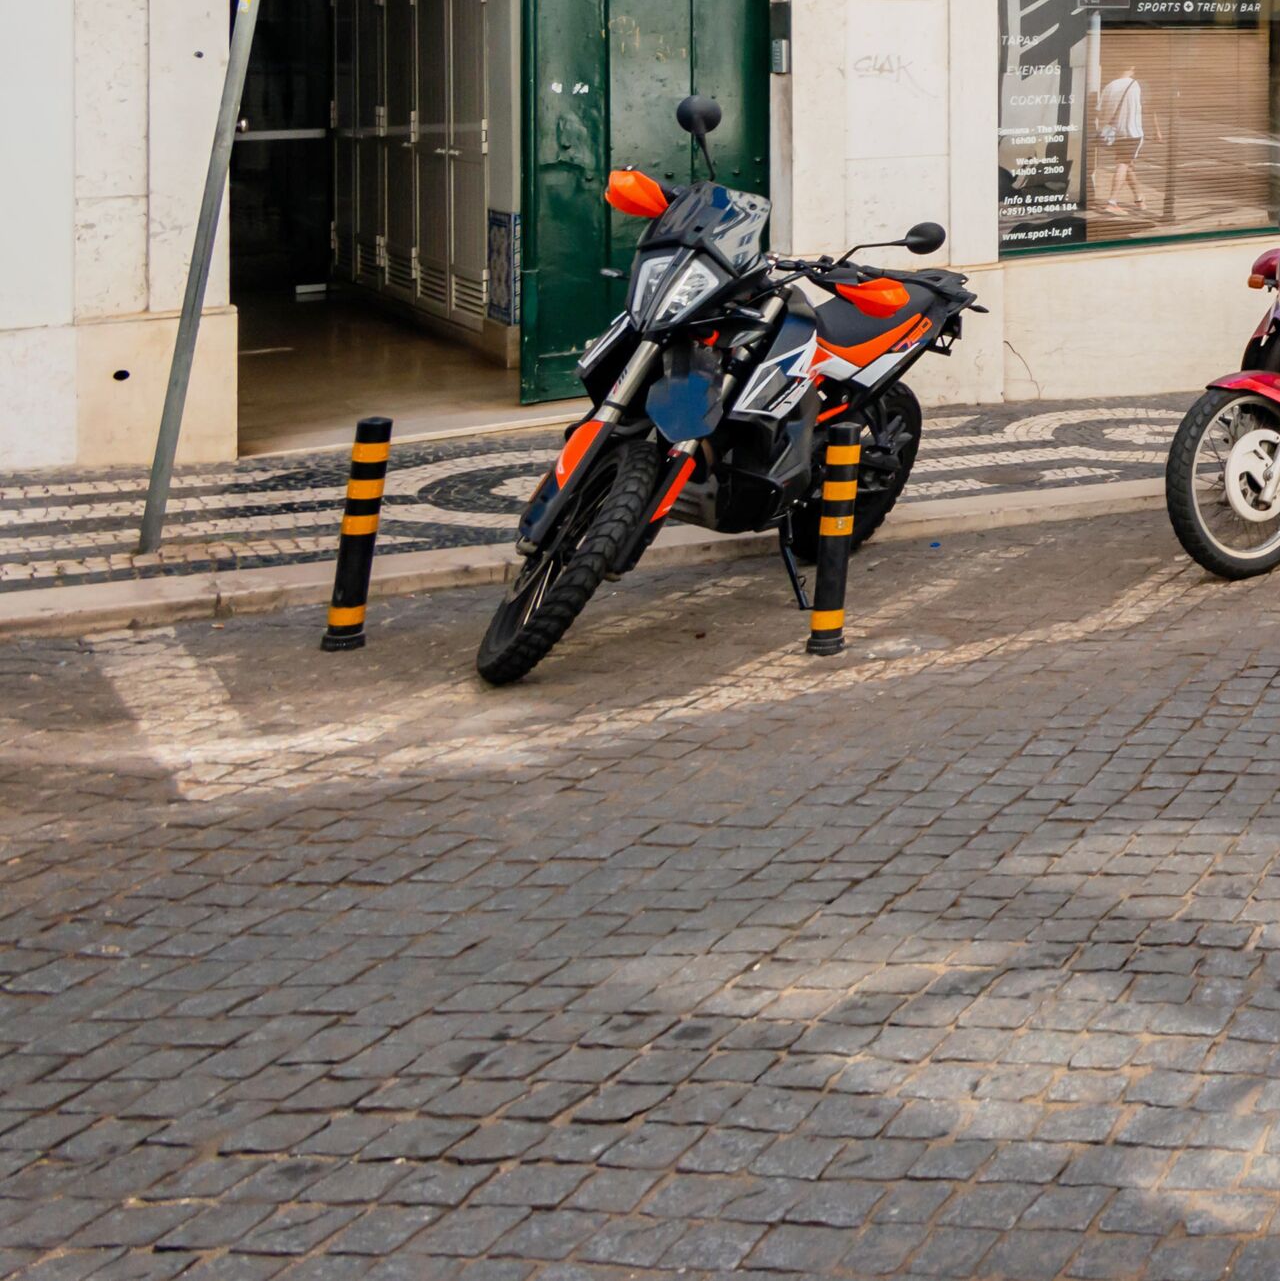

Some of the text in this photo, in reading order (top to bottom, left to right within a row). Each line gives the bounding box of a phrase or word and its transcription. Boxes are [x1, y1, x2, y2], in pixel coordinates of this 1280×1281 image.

[1137, 2, 1262, 12] SPORTS TRENDY BAR
[1001, 35, 1040, 46] TAPAS
[1006, 65, 1061, 76] EVENTOS
[1009, 94, 1075, 106] COCKTAILS
[1037, 125, 1053, 133] The
[1011, 168, 1036, 177] 14h00
[1044, 166, 1064, 175] 2h00
[1004, 195, 1023, 205] Info
[1025, 195, 1032, 203] &
[1034, 194, 1064, 203] reserv
[1000, 203, 1077, 216] (+351) 960 404 184
[1002, 227, 1072, 240] www.spot-lx.pt
